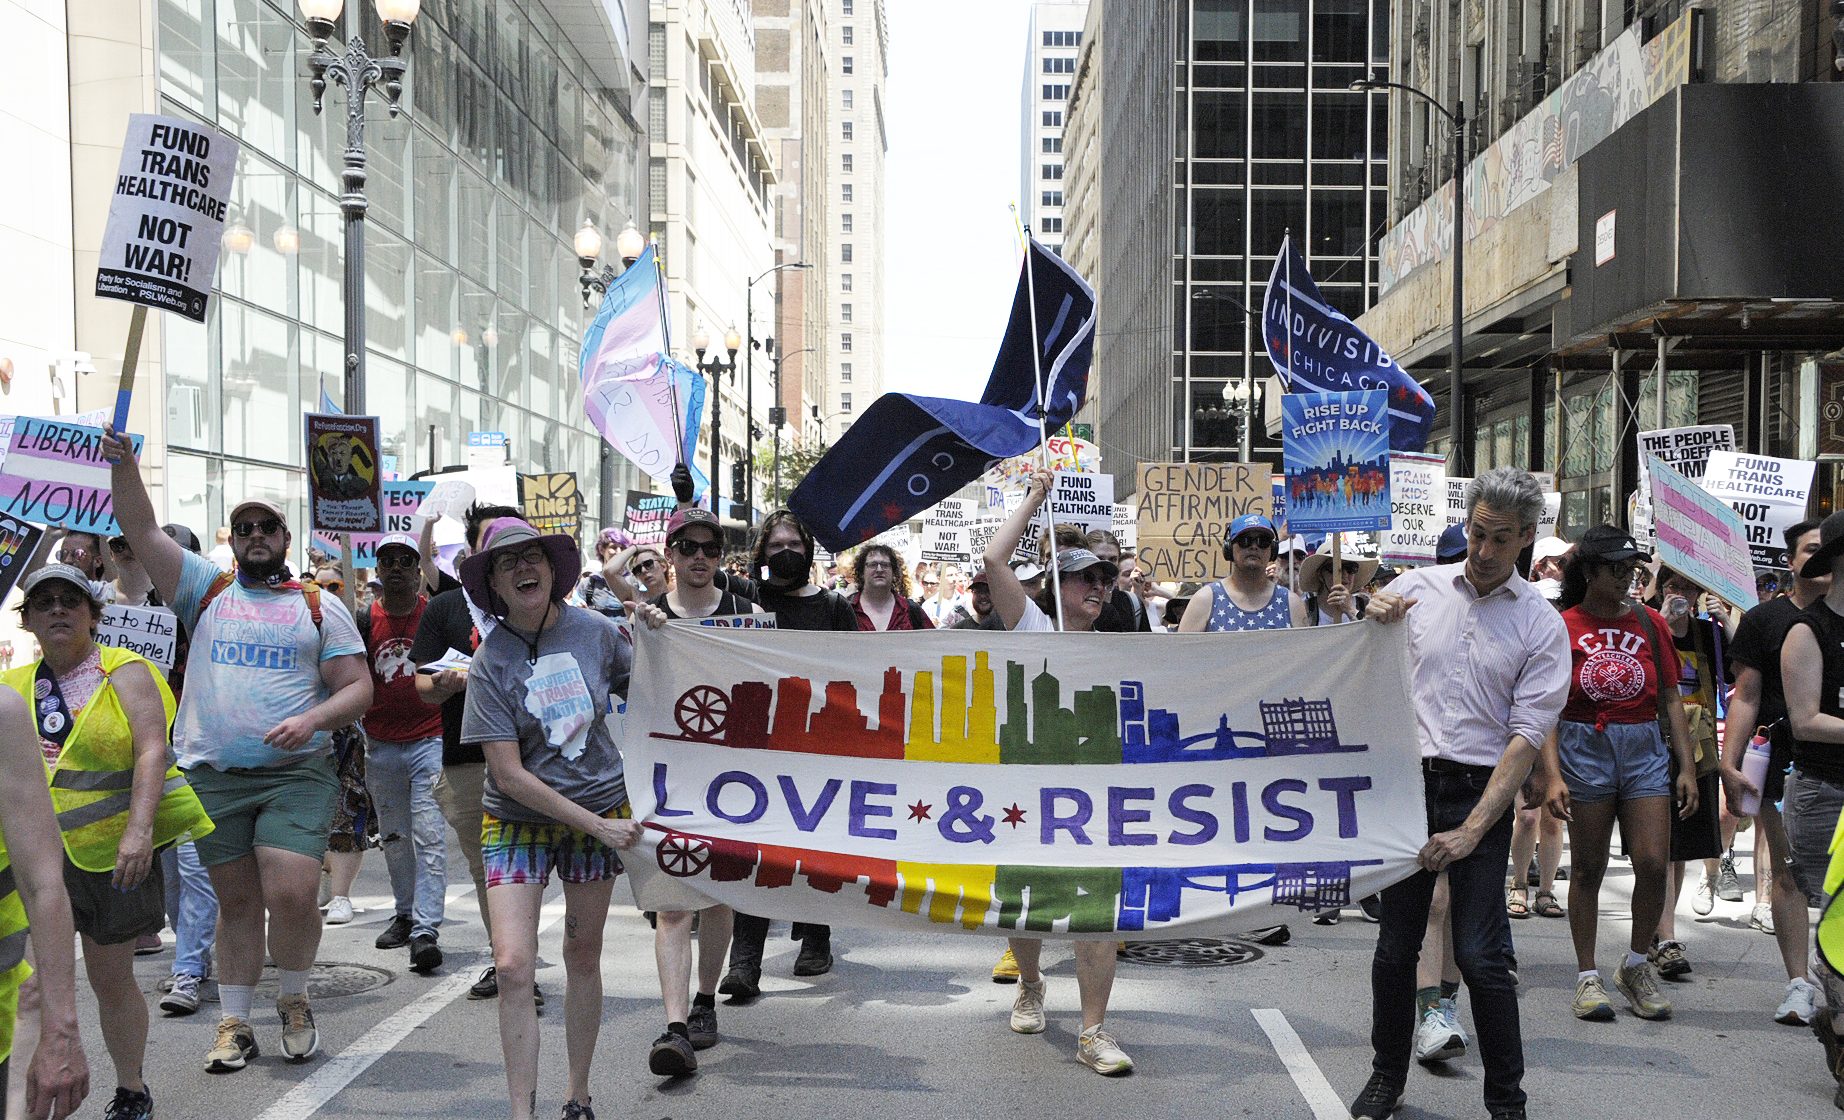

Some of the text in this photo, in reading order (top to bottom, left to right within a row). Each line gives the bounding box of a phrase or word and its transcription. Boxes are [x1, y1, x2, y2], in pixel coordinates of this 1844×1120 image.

[150, 123, 210, 160] FUND
[140, 149, 211, 189] TRANS
[116, 175, 227, 223] HEALTHCARE
[137, 213, 193, 249] NOT
[124, 243, 192, 283] WAR!
[99, 273, 183, 298] Party for Socialism and
[97, 282, 188, 311] Liberation PSLWeb.org
[1303, 403, 1369, 420] RISE UP
[1291, 418, 1383, 439] FIGHT BACK
[1643, 430, 1729, 451] THE PEOPLE
[1734, 457, 1781, 474] FUND
[523, 473, 576, 499] NO
[1061, 475, 1092, 489] FUND
[1144, 465, 1255, 493] GENDER
[1393, 470, 1433, 486] TRANS
[1447, 481, 1463, 490] THE
[1727, 468, 1784, 487] TRANS
[1057, 488, 1096, 503] TRANS
[1401, 486, 1429, 501] KIDS
[1447, 490, 1465, 499] WILL
[1705, 479, 1806, 501] HEALTHCARE
[6, 480, 115, 531] NOW!
[524, 497, 577, 517] KINGS
[625, 505, 663, 522] SILENT
[638, 497, 677, 510] STAYIN
[935, 509, 964, 519] TRANS
[938, 500, 962, 510] FUND
[1136, 491, 1264, 523] AFFIRMING
[1391, 502, 1436, 517] DESERVE
[1447, 498, 1467, 510] TRU
[1657, 466, 1738, 542] PROTECT
[1732, 501, 1771, 523] NOT
[629, 519, 662, 533] TIMES
[925, 518, 975, 528] HEALTHCARE
[968, 528, 982, 537] THE
[1064, 522, 1089, 536] OT
[1402, 518, 1426, 532] OUR
[938, 531, 958, 541] NOT
[1017, 537, 1039, 553] FIGH
[1172, 521, 1231, 548] CAR
[1660, 498, 1749, 577] TRANS
[934, 542, 960, 553] WAR!
[1138, 546, 1209, 580] SAVES
[1673, 538, 1744, 601] KIDS
[119, 609, 139, 628] to
[145, 613, 173, 636] the
[215, 618, 297, 646] TRANS
[117, 633, 174, 665] People!
[1577, 628, 1646, 655] CTU
[214, 641, 296, 668] YOUTH
[528, 668, 579, 692] PROTECT
[533, 680, 586, 707] TRANS
[653, 762, 1373, 847] LOVE & RESIST
